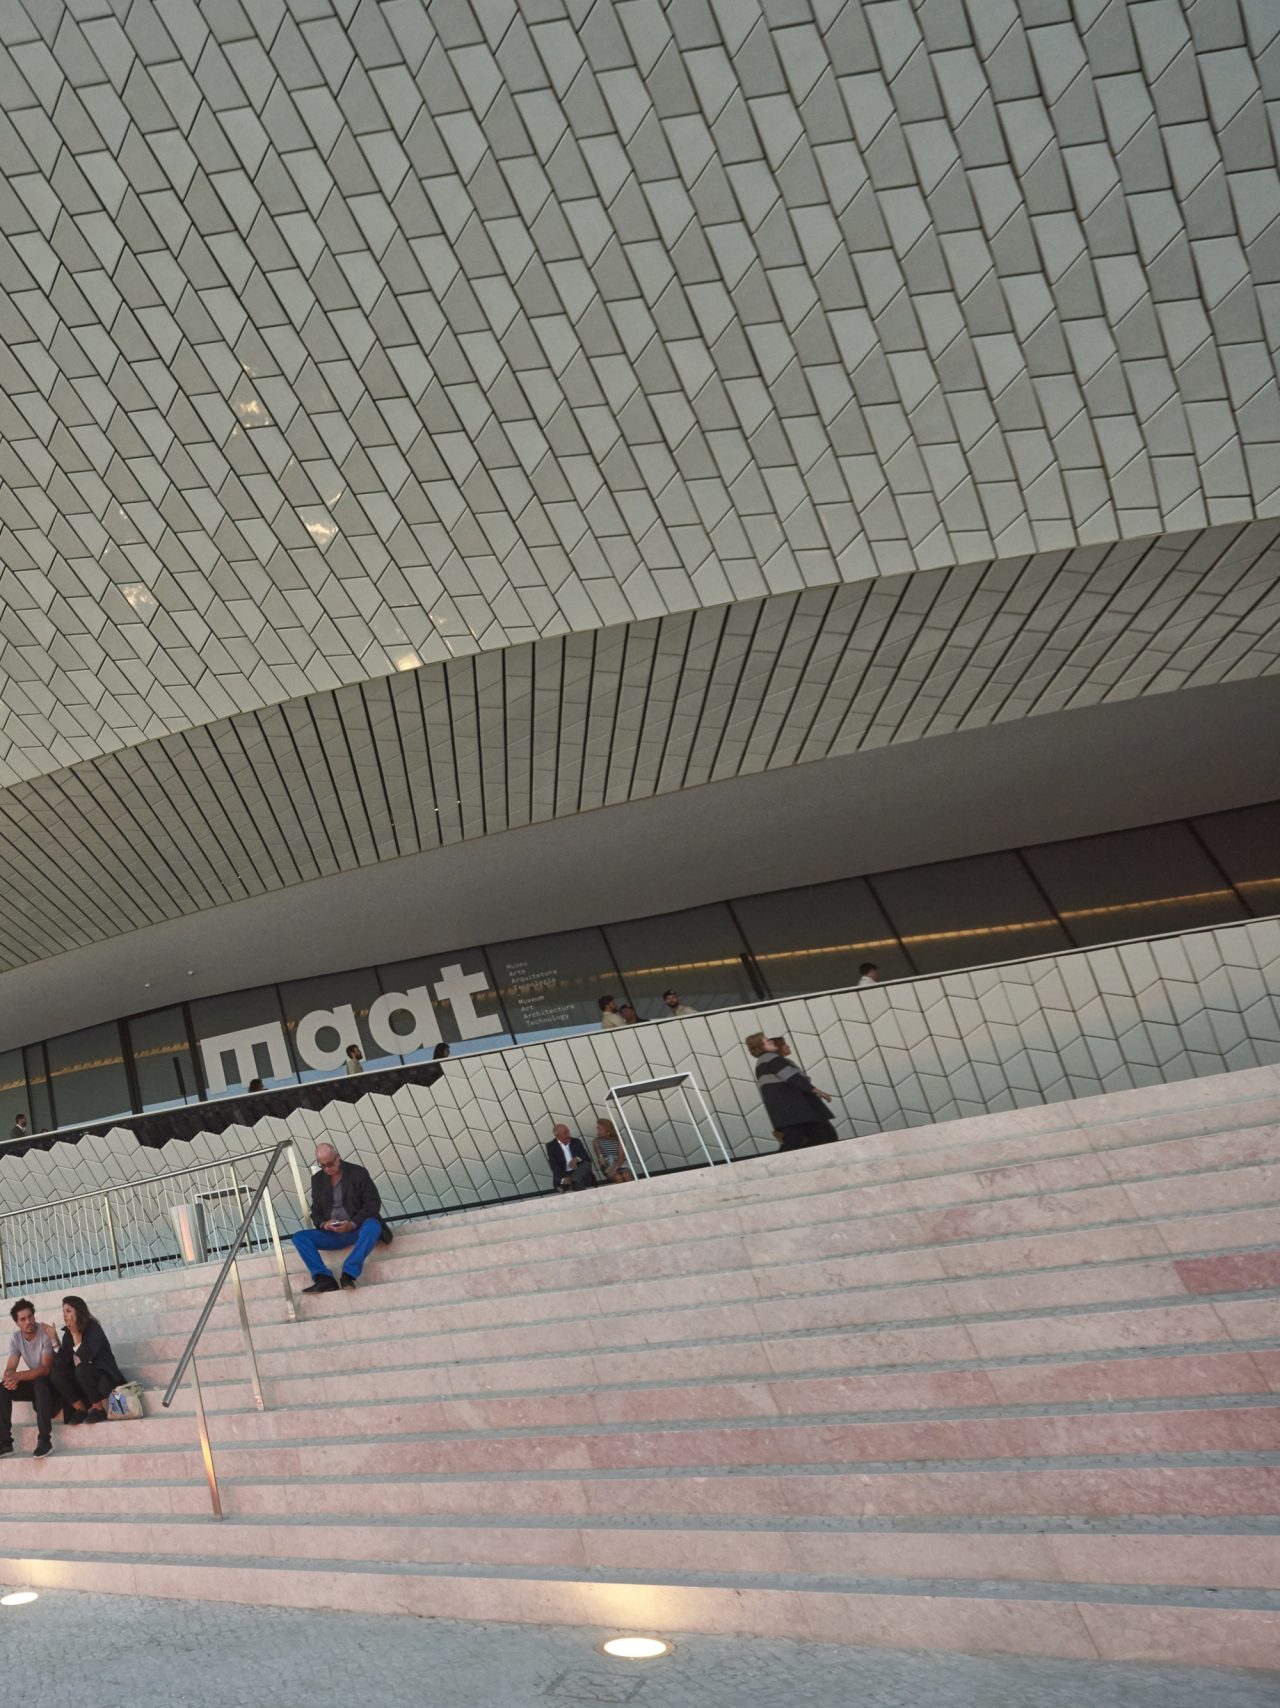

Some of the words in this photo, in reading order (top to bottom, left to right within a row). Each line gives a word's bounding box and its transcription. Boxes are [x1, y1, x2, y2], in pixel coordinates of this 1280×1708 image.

[518, 996, 544, 1005] Museum
[524, 1004, 574, 1019] Architecture
[526, 1014, 569, 1026] Technology
[200, 964, 503, 1094] maat
